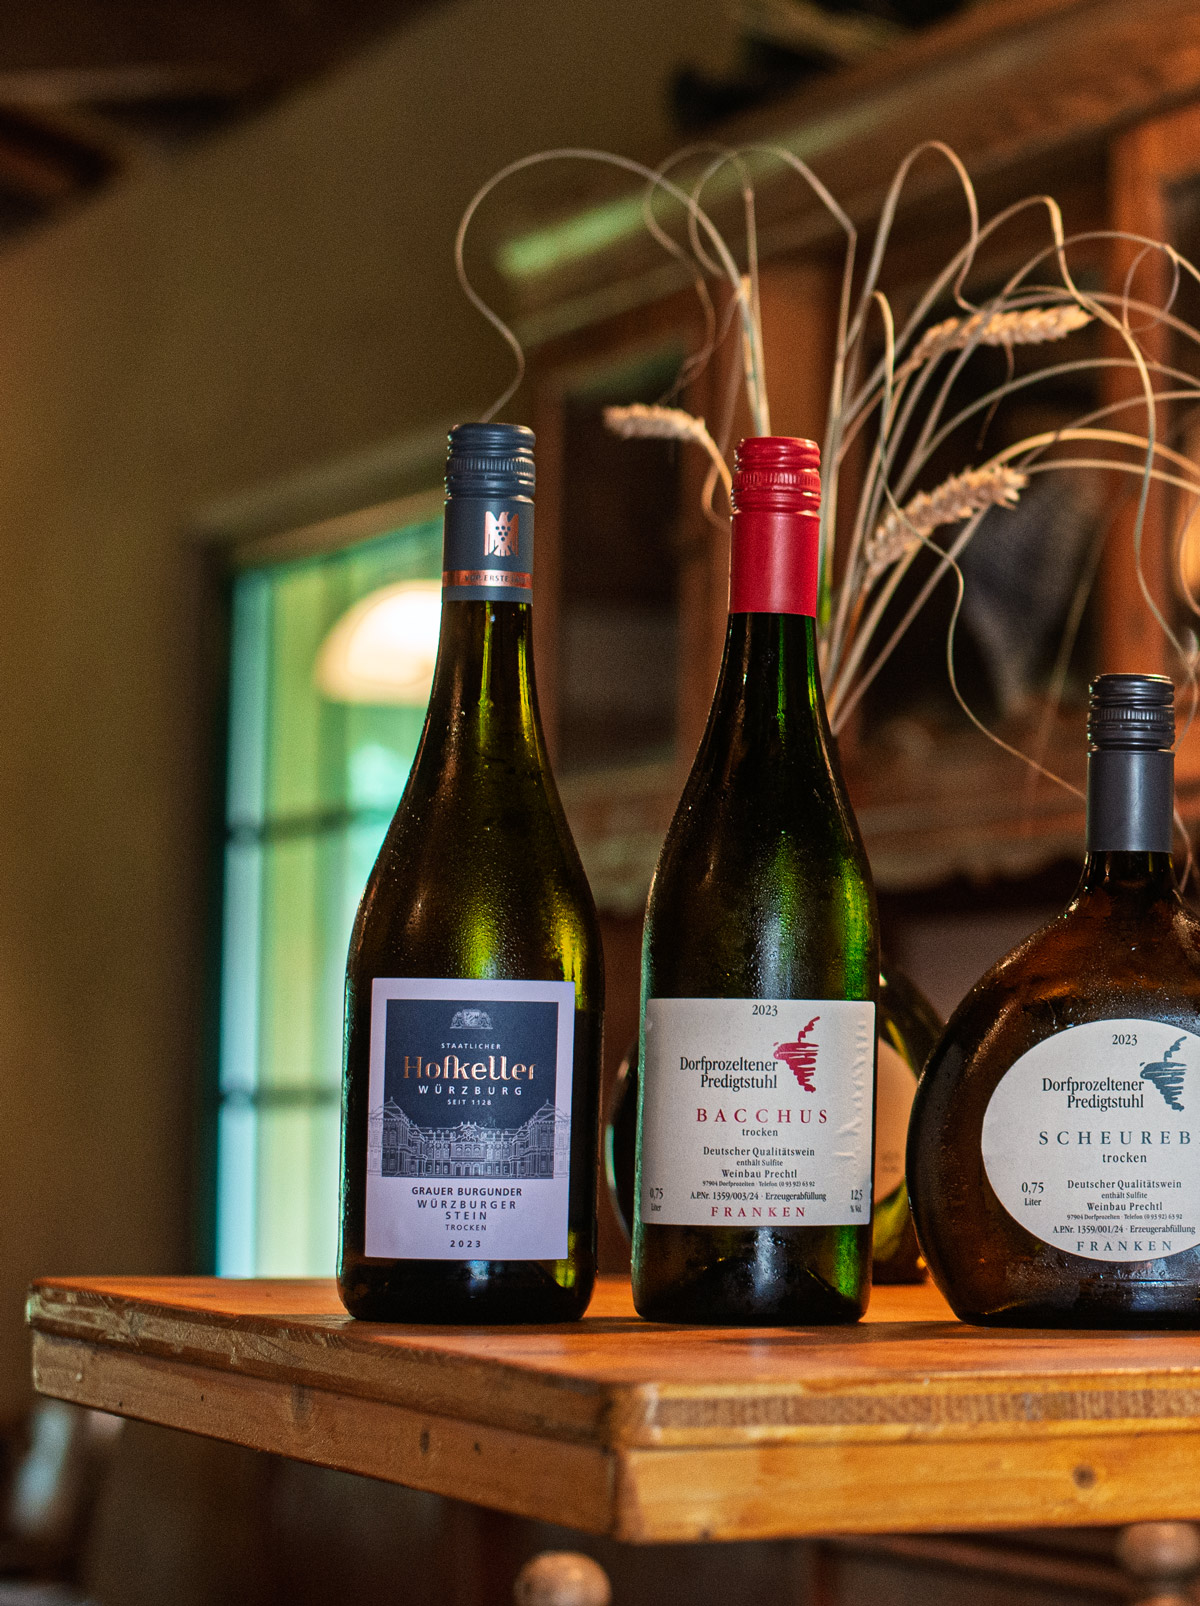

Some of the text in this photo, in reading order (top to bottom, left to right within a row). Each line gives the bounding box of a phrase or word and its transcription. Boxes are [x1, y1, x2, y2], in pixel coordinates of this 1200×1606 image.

[752, 1004, 778, 1016] 2023
[1111, 1034, 1138, 1046] 2023
[441, 1042, 501, 1050] STAATLICHER
[403, 1054, 537, 1080] Hofkeller
[680, 1056, 778, 1074] Dorfprozeltener
[700, 1074, 777, 1092] Predigtstuhl
[1042, 1077, 1144, 1095] Dorfprozeltener
[418, 1084, 523, 1096] WÜRZBURG
[1067, 1094, 1144, 1112] Predigtstuhl
[696, 1108, 828, 1124] BACCHUS
[742, 1128, 778, 1137] trocken
[703, 1146, 815, 1158] Deutscher Qualitätswein
[1102, 1152, 1147, 1163] trocken
[722, 1169, 797, 1178] Weinbau Prechtl
[1021, 1181, 1044, 1195] 0,75
[1067, 1179, 1182, 1191] Deutscher Qualitätswein
[411, 1186, 522, 1197] GRAUER BURGUNDER
[649, 1187, 664, 1200] 0,75
[713, 1191, 759, 1201] 1359/003/24
[765, 1191, 827, 1202] Erzeugerabfüllung
[1101, 1191, 1148, 1199] enthält Sulfite
[417, 1199, 517, 1210] WÜRZBURGER
[1024, 1197, 1042, 1207] Liter
[1087, 1202, 1163, 1211] Weinbau Prechtl
[445, 1211, 487, 1220] STEIN
[711, 1206, 805, 1217] FRANKEN
[1077, 1225, 1123, 1234] 1359/001/24
[1130, 1224, 1196, 1235] Erzeugerabfüllung
[450, 1240, 481, 1248] 2023
[1077, 1240, 1172, 1251] FRANKEN
